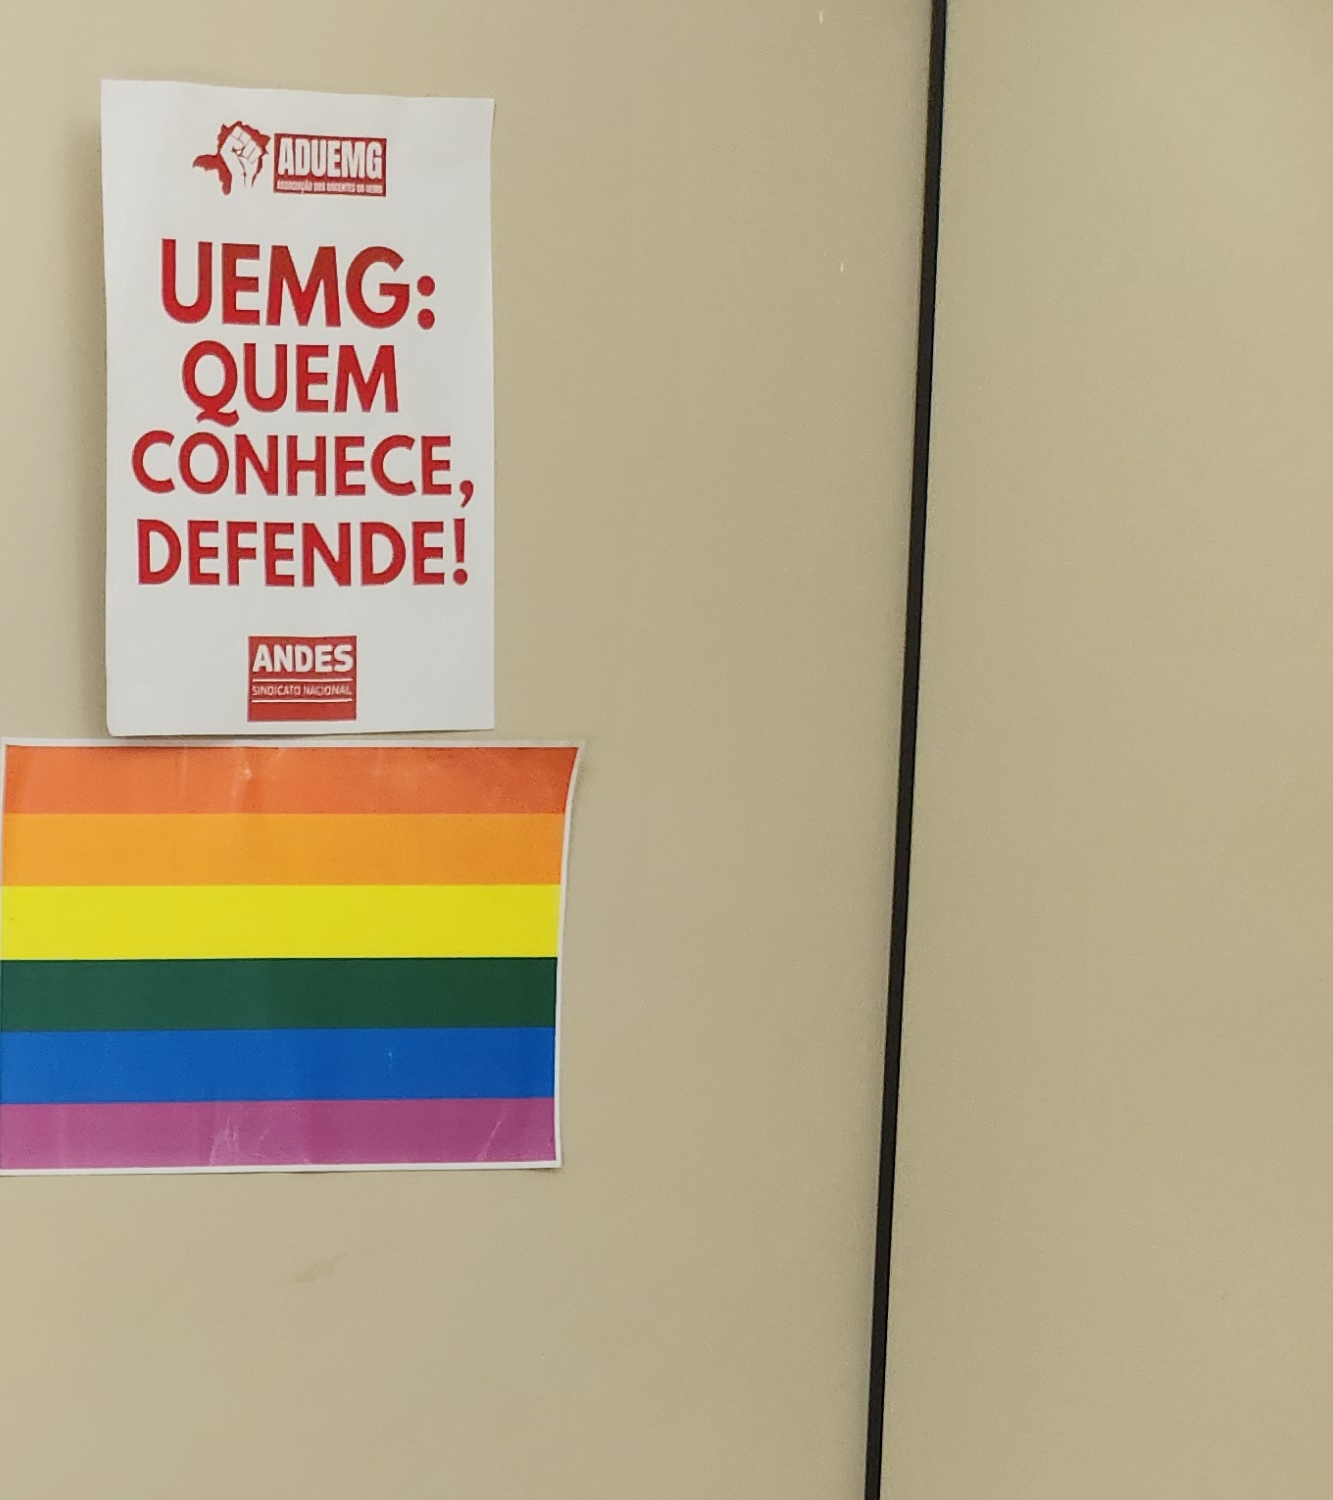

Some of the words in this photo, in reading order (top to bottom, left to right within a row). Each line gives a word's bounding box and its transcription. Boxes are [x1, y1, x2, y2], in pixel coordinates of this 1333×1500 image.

[278, 137, 382, 180] ADUEMG
[161, 237, 436, 331] UEMG:
[181, 340, 399, 426] QUEM
[131, 430, 475, 507] CONHECE,
[137, 517, 469, 588] DEFENDE!
[252, 644, 353, 672] ANDES
[252, 684, 301, 696] SINDICATO
[303, 684, 352, 696] NACIONAL
